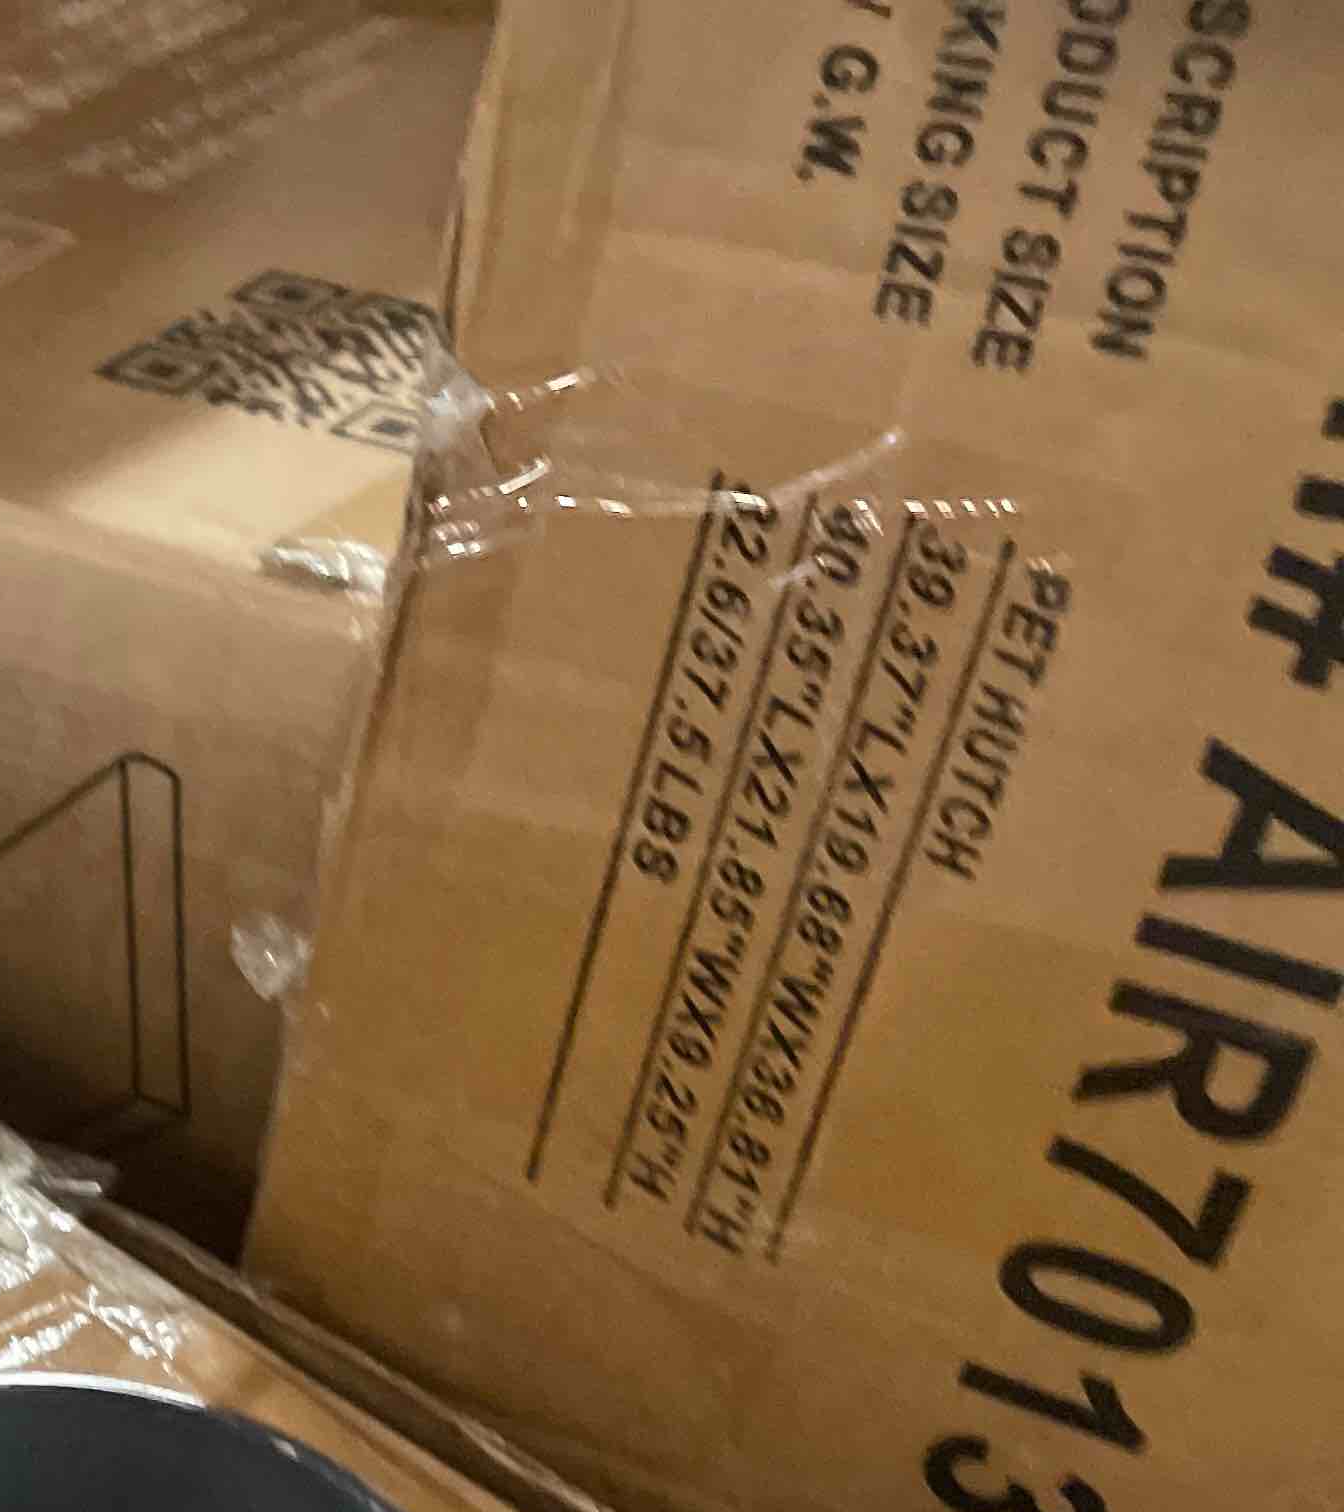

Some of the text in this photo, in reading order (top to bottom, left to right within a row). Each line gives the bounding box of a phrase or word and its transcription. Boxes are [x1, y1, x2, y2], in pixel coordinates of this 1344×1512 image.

[792, 39, 883, 194] G.W.
[870, 179, 963, 328] SIZE
[967, 227, 1065, 376] SIZE
[917, 561, 1075, 885] PET HUTCH
[626, 760, 704, 887] LBS
